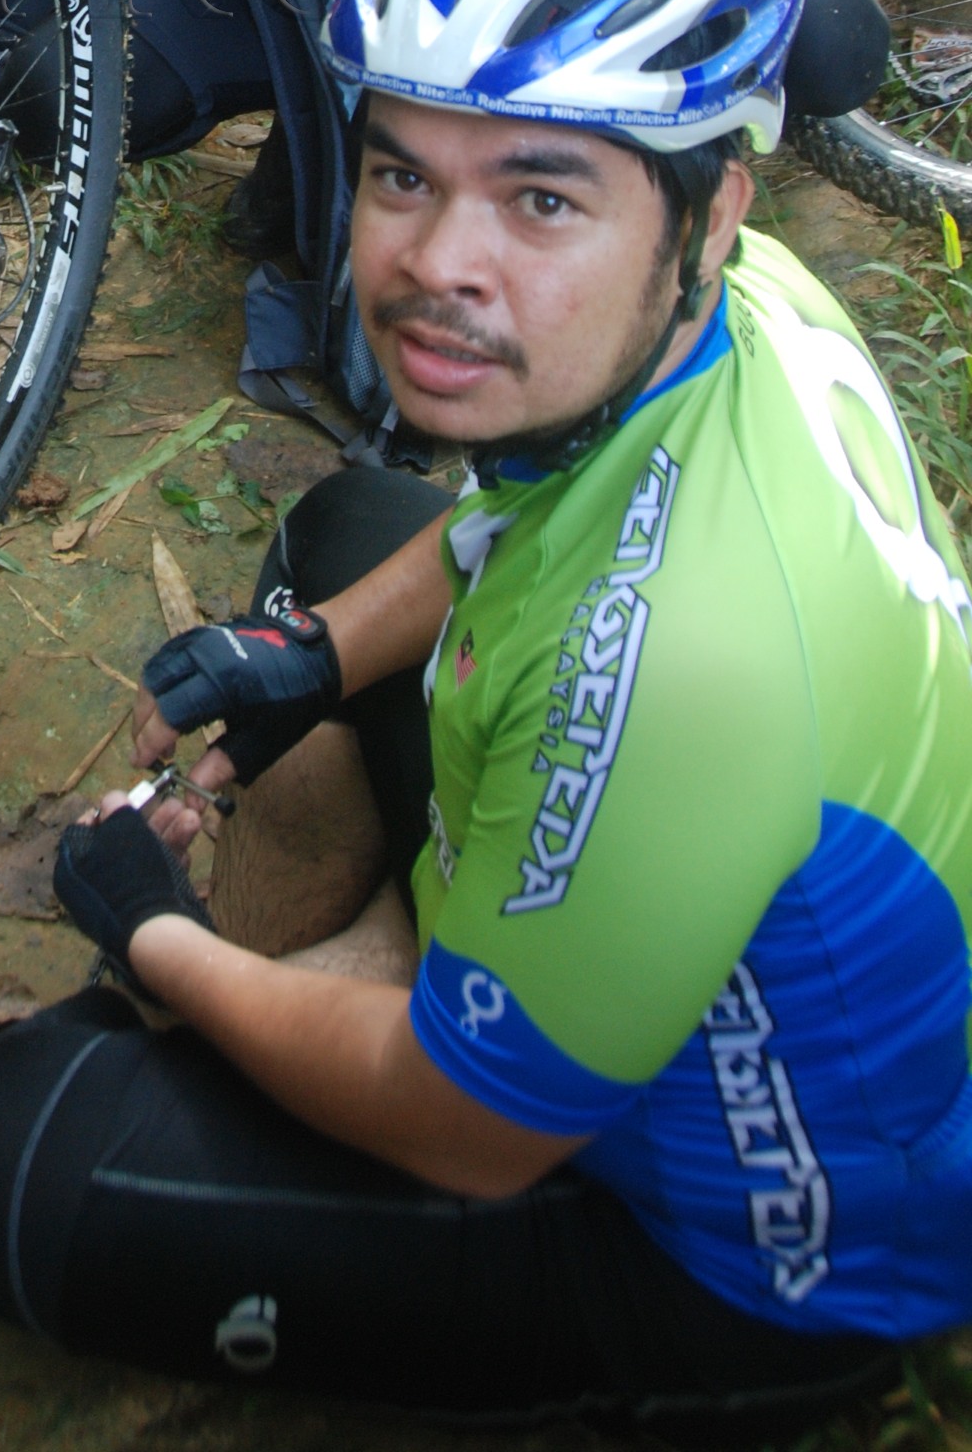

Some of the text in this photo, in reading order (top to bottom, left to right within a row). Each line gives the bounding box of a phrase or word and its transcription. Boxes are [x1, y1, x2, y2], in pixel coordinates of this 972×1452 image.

[478, 92, 547, 118] Reflective
[551, 105, 612, 123] NiteSafe
[615, 109, 676, 126] Reflective
